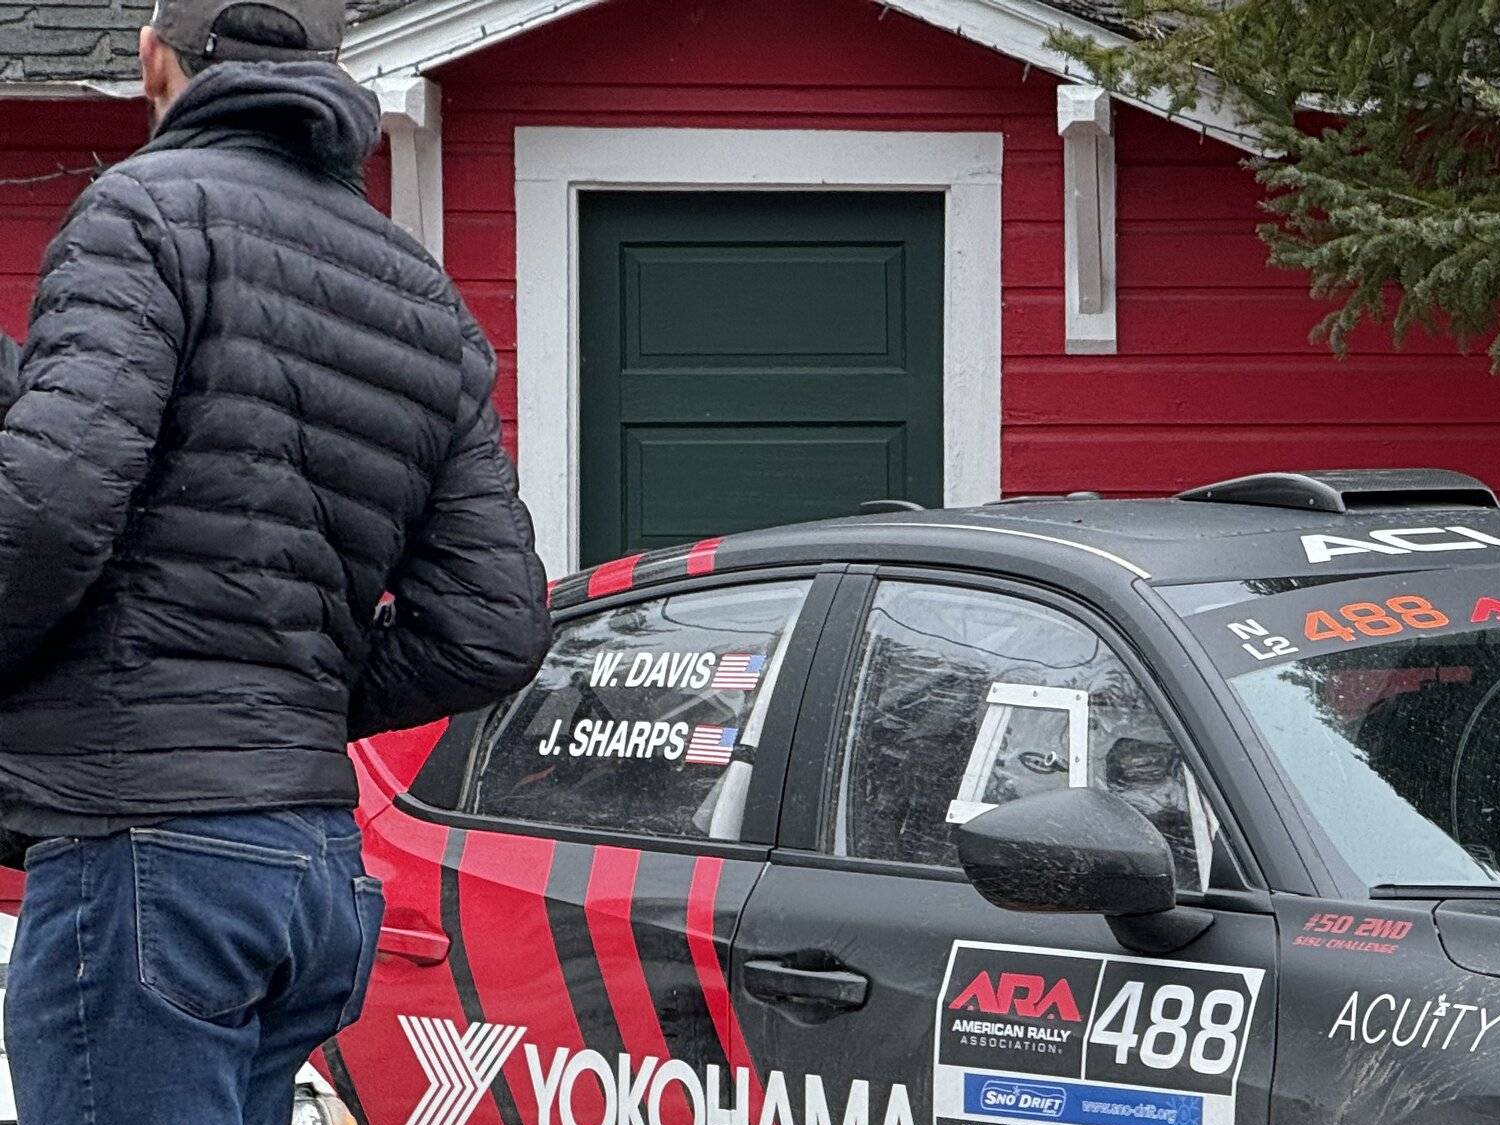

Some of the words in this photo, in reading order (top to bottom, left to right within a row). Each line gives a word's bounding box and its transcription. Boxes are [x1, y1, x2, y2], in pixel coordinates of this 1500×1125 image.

[1304, 595, 1450, 642] 488
[589, 651, 617, 688] W.
[624, 651, 716, 690] DAVIS
[538, 718, 562, 757] J.
[568, 718, 689, 761] SHARPS
[1353, 916, 1414, 941] 2WD
[948, 970, 1082, 1022] ARA
[951, 1019, 1025, 1039] AMERICAN
[1026, 1025, 1072, 1043] RALLY
[1089, 980, 1246, 1075] 488
